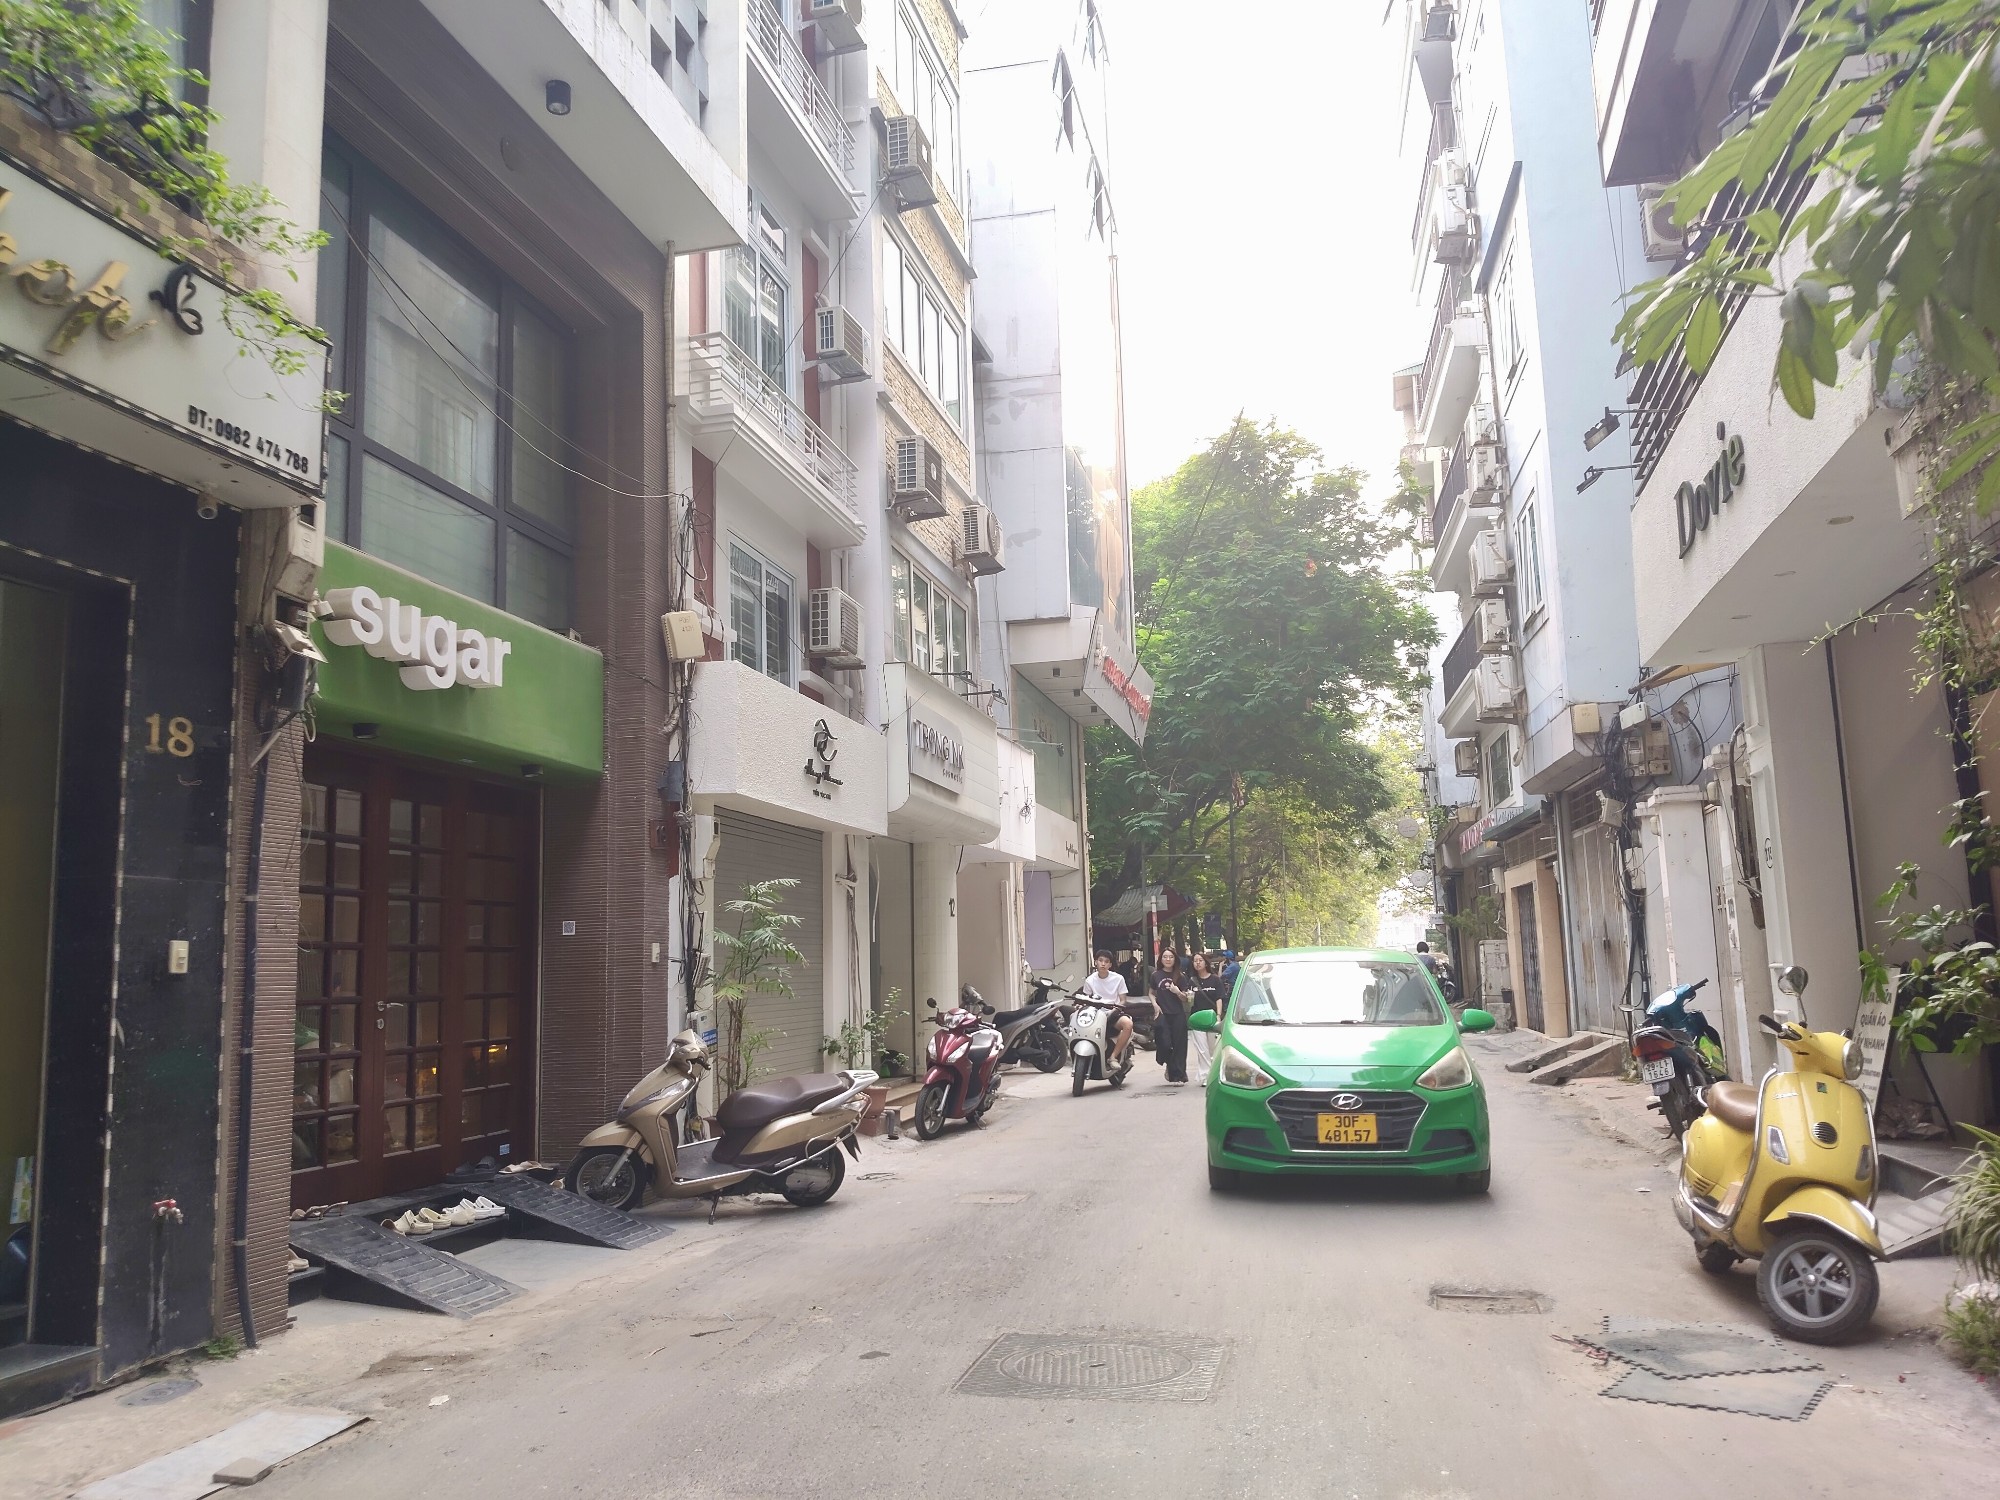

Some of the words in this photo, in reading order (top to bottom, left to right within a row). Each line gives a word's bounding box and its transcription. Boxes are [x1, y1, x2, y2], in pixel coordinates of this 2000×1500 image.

[256, 436, 281, 462] 474
[285, 448, 309, 474] 788
[1673, 421, 1745, 559] Dovie
[326, 586, 512, 690] sugar
[145, 712, 195, 757] 18
[948, 898, 956, 917] 12
[1877, 1012, 1887, 1026] ÁO
[1324, 1129, 1372, 1142] 481.57
[1334, 1115, 1360, 1128] 30F
